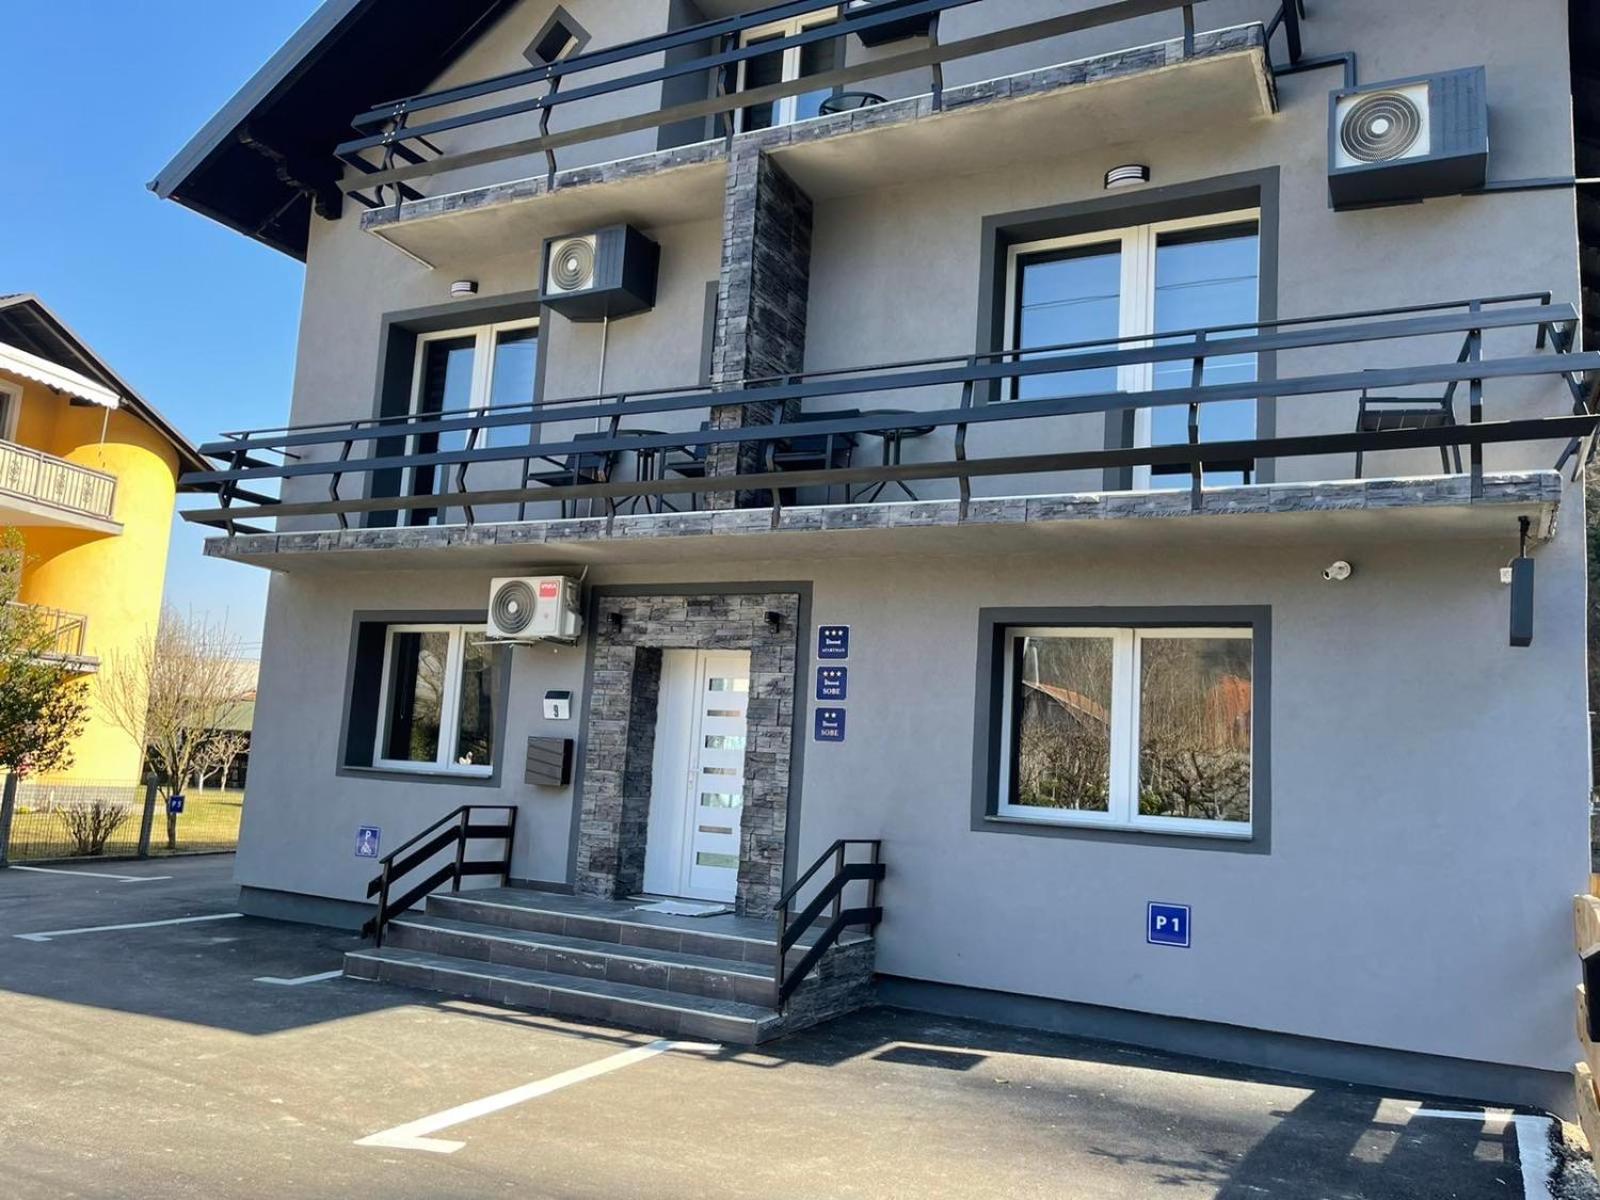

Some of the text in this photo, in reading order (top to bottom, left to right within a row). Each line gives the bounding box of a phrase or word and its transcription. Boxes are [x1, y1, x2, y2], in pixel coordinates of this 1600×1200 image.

[822, 687, 841, 695] SOBE
[553, 704, 559, 718] 9
[365, 830, 372, 841] P
[1156, 915, 1179, 932] P 1
